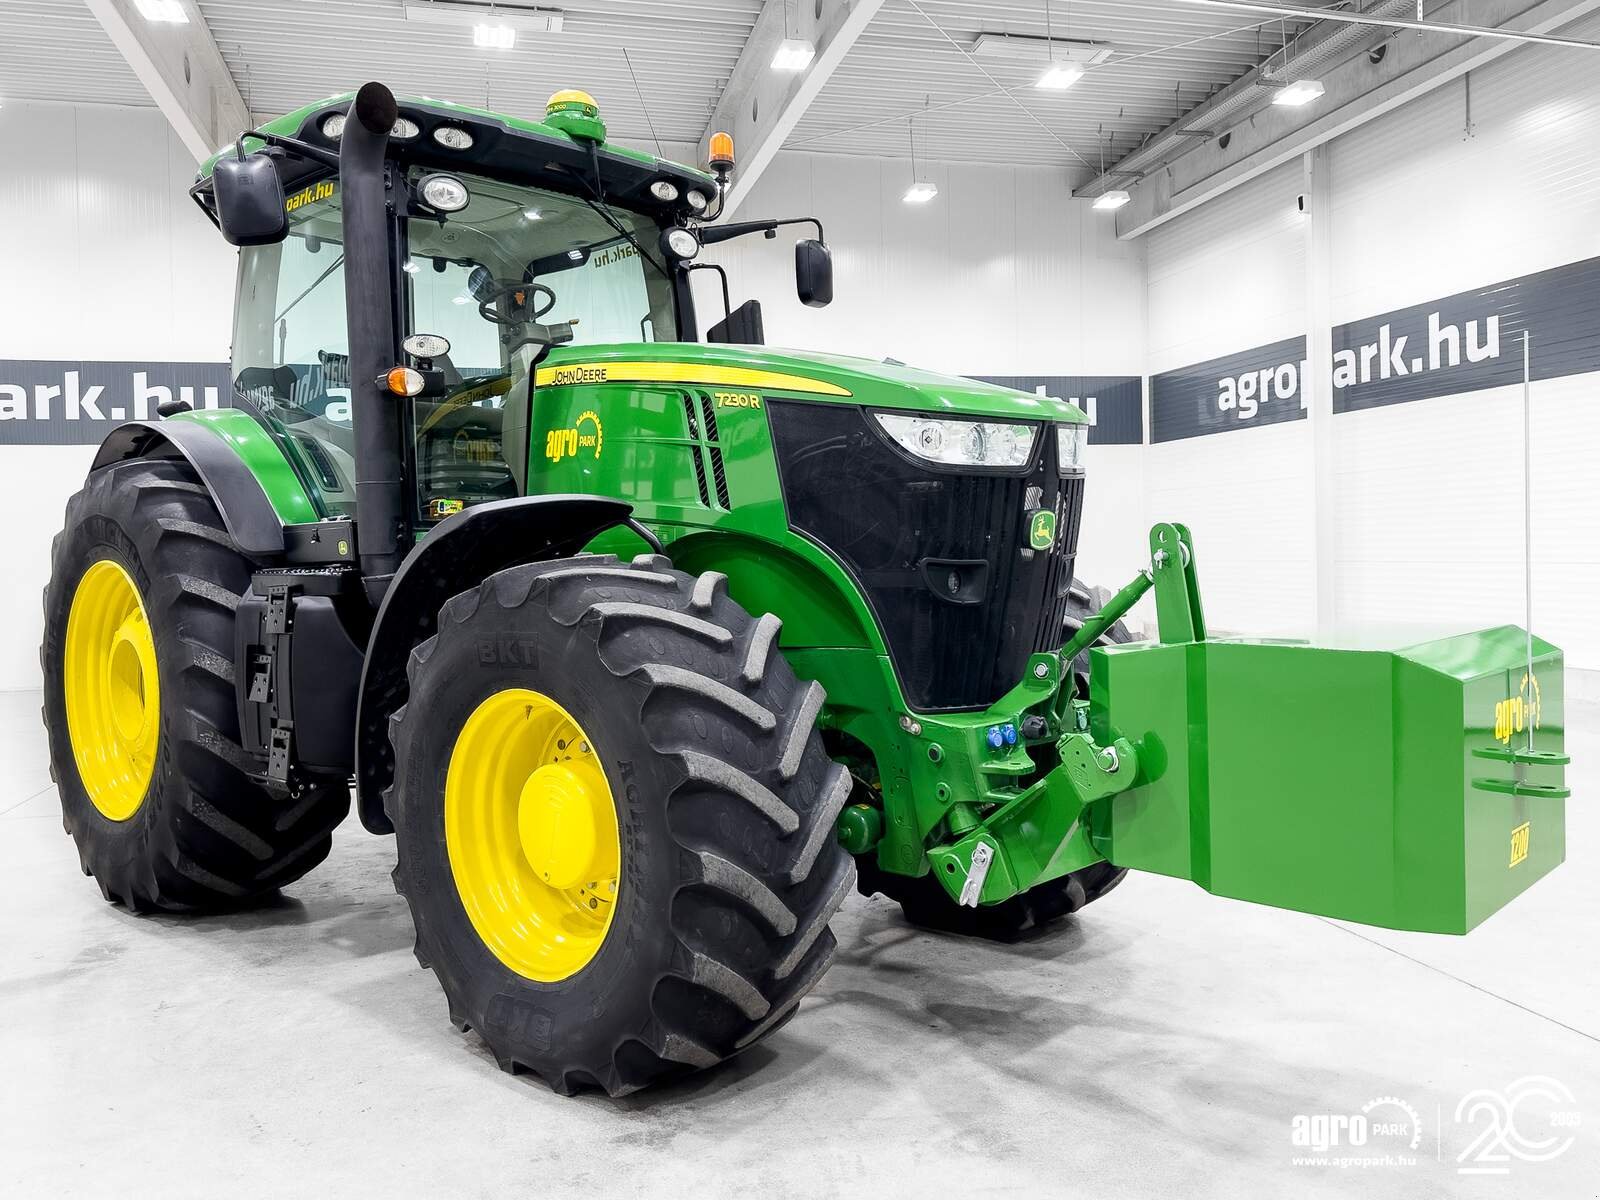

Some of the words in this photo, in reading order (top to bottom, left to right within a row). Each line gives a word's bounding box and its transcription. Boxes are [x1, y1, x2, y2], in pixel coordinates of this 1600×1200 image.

[552, 368, 575, 385] JOHN
[575, 367, 608, 382] DEERE
[546, 428, 578, 462] agro
[579, 434, 596, 447] PARK
[479, 640, 537, 665] BKT
[1495, 695, 1524, 744] agro
